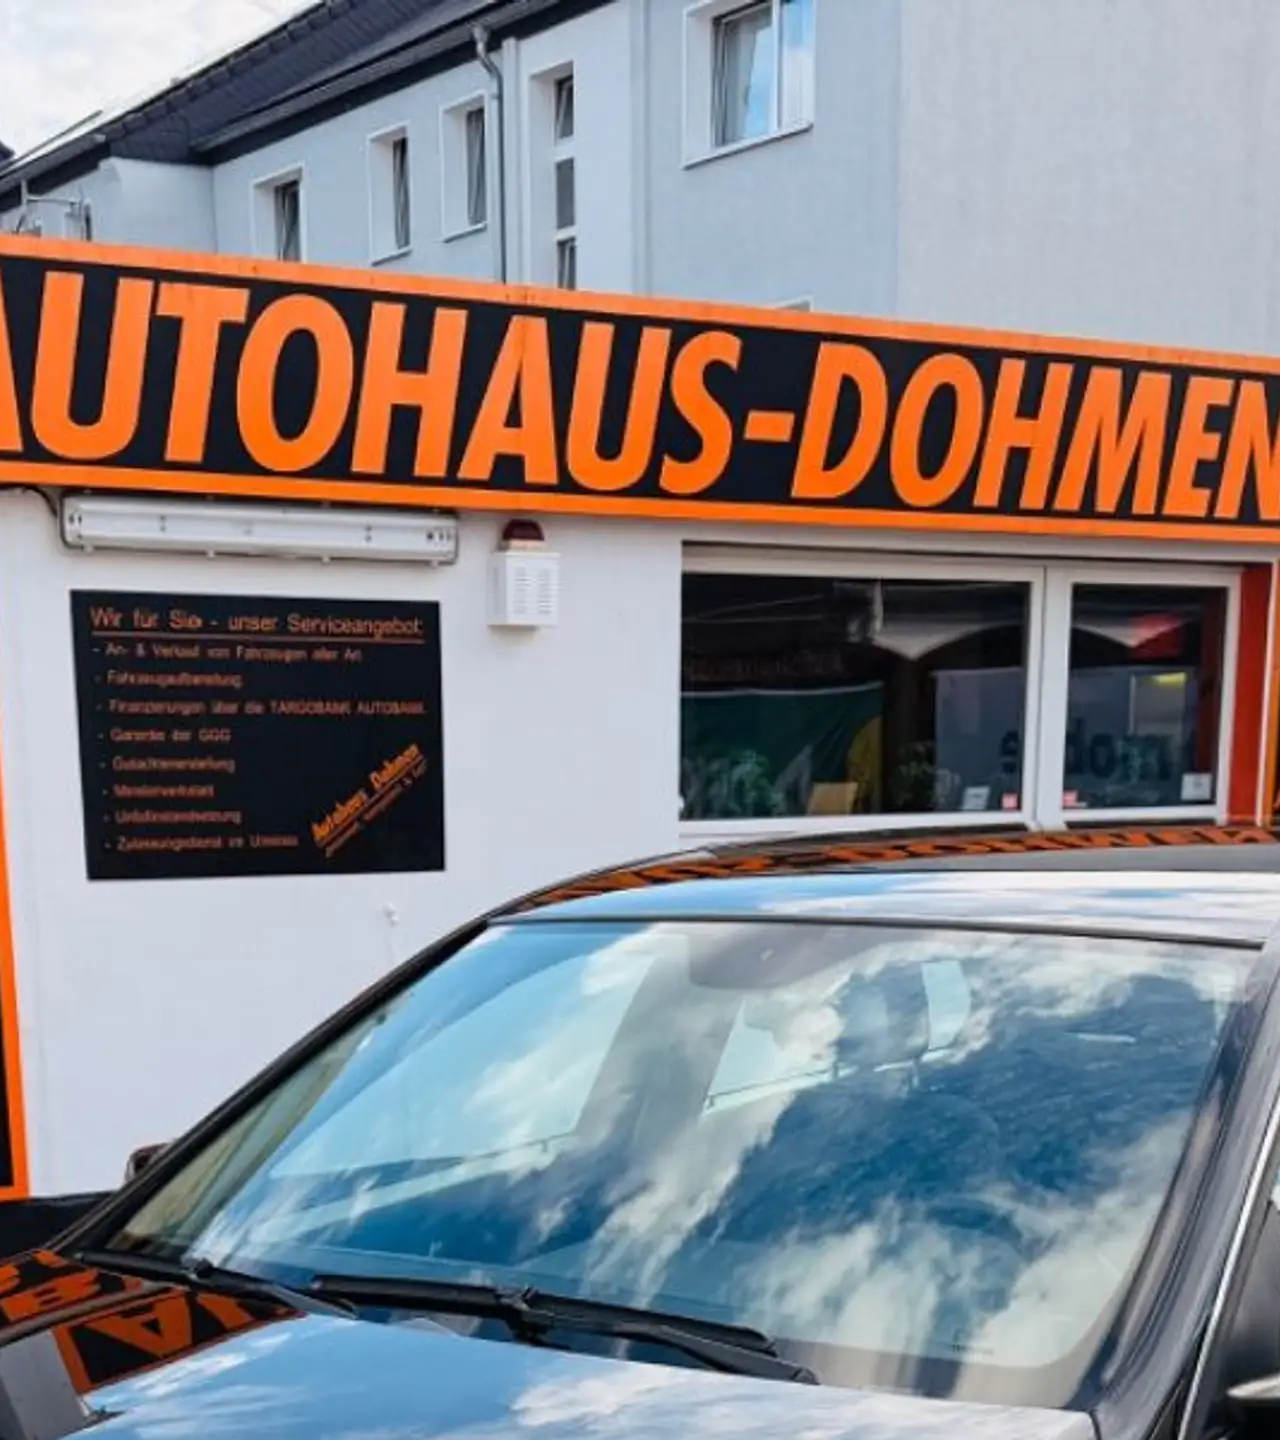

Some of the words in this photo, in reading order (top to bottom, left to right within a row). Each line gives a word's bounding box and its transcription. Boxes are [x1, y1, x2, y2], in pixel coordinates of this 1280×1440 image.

[90, 607, 122, 627] Wir
[133, 608, 159, 629] für
[228, 615, 279, 631] unser
